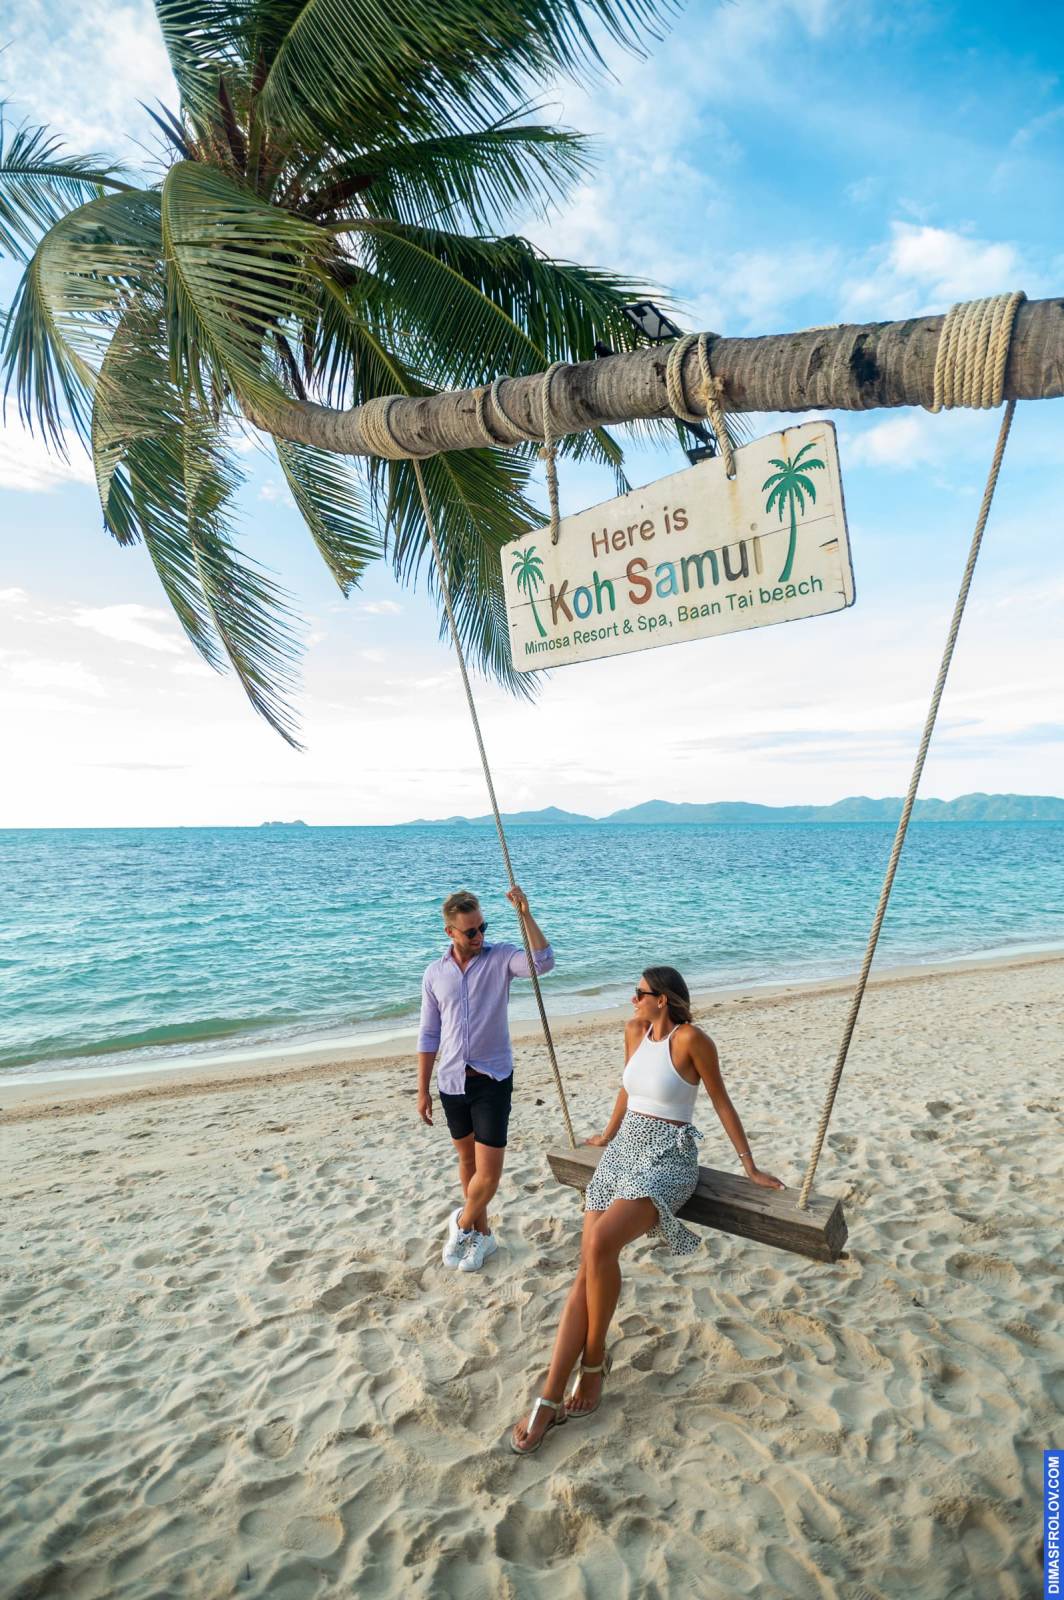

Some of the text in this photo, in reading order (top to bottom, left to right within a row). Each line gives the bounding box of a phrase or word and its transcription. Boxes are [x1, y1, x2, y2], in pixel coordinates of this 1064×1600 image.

[591, 505, 689, 558] Here is
[524, 574, 823, 656] Mimosa Resort & Spa, Baan Tai beach
[550, 522, 763, 626] Koh Samui
